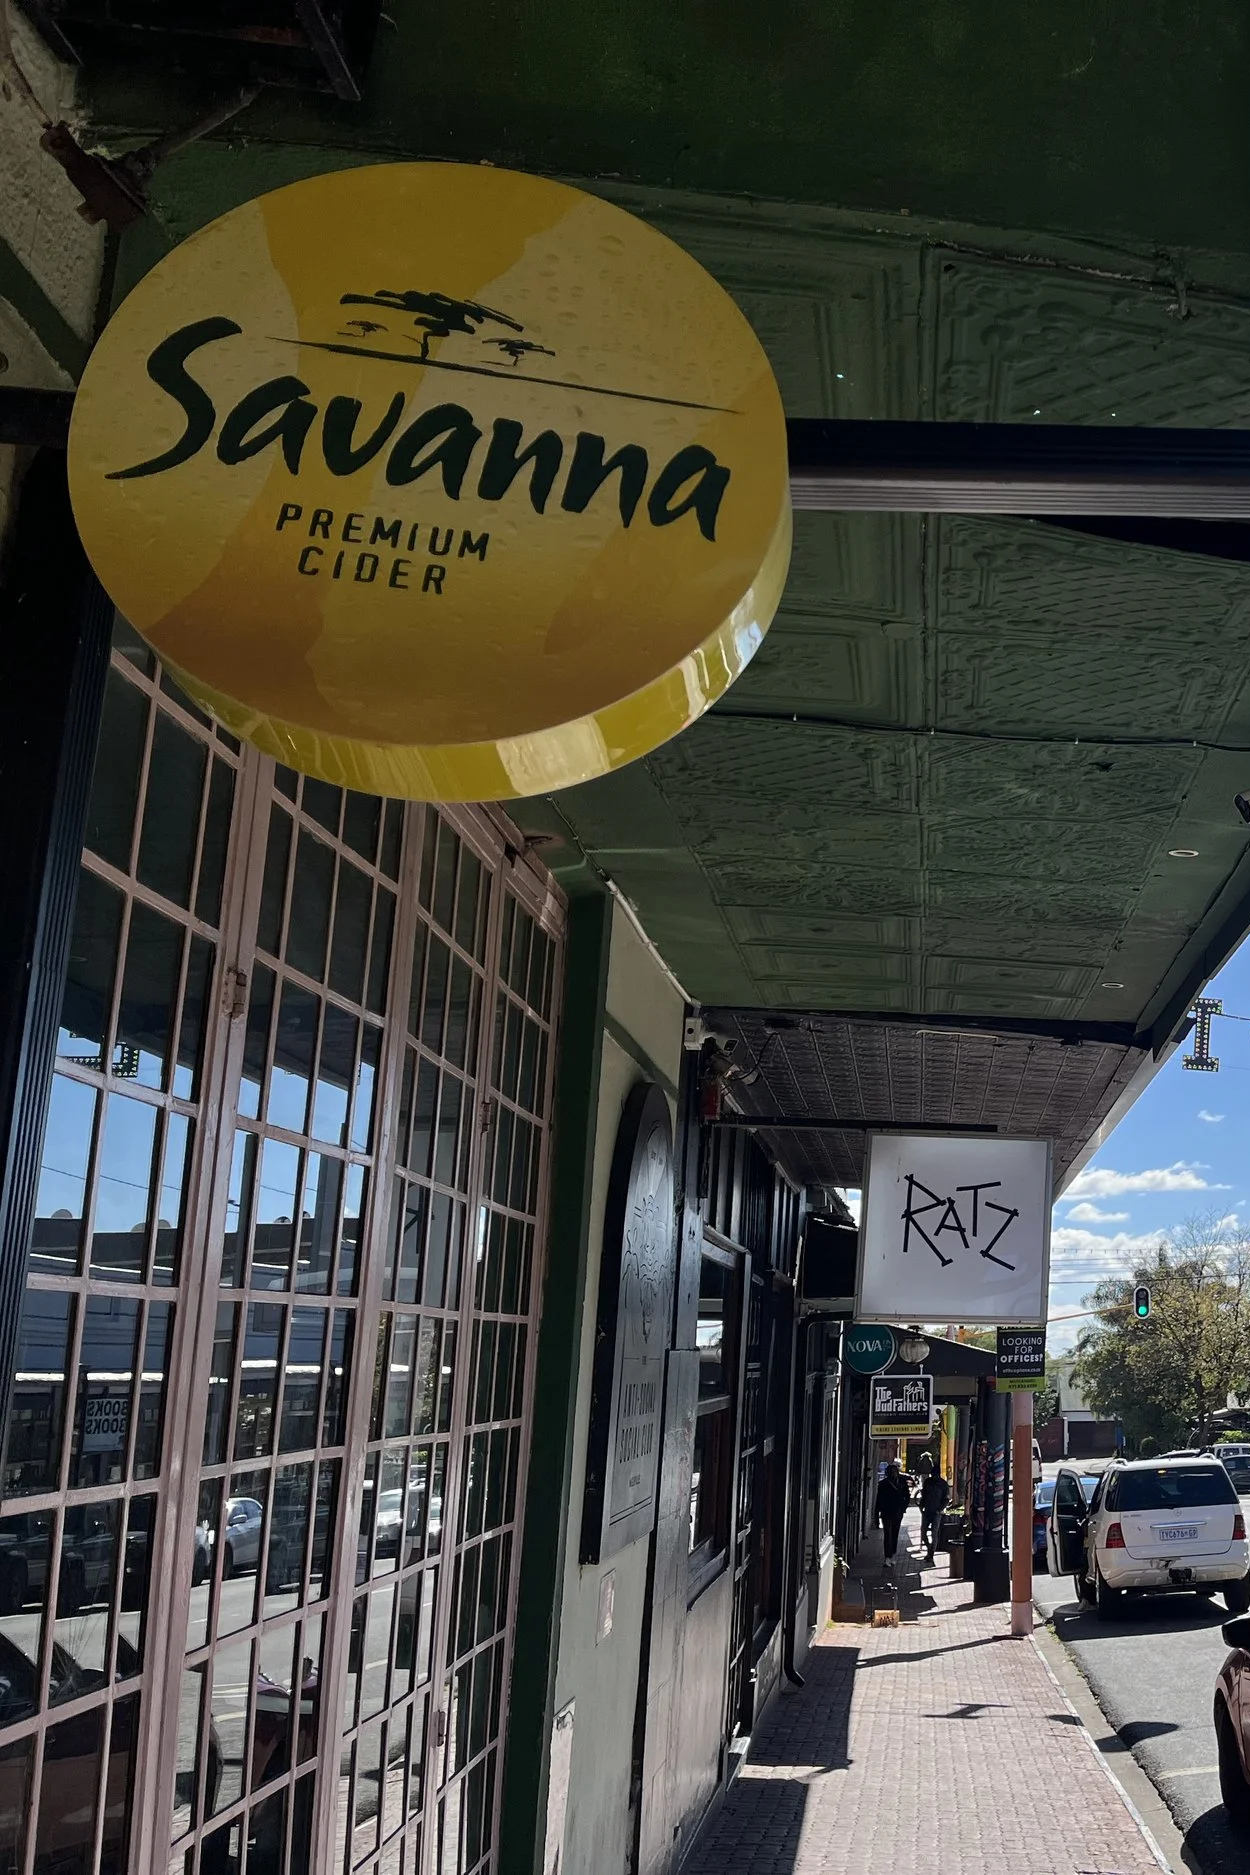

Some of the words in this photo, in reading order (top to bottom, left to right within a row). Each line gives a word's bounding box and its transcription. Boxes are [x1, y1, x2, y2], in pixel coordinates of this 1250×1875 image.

[104, 315, 733, 542] Savanna
[275, 502, 490, 562] PREMIUM
[297, 545, 447, 595] CIDER
[1182, 997, 1223, 1072] I
[900, 1173, 1020, 1271] RATZ
[847, 1340, 882, 1352] NOVA
[1002, 1337, 1043, 1346] LOOKING
[1014, 1346, 1033, 1354] FOR
[1000, 1354, 1044, 1363] OFFICES?
[875, 1386, 892, 1401] The
[875, 1398, 928, 1412] BudFathers
